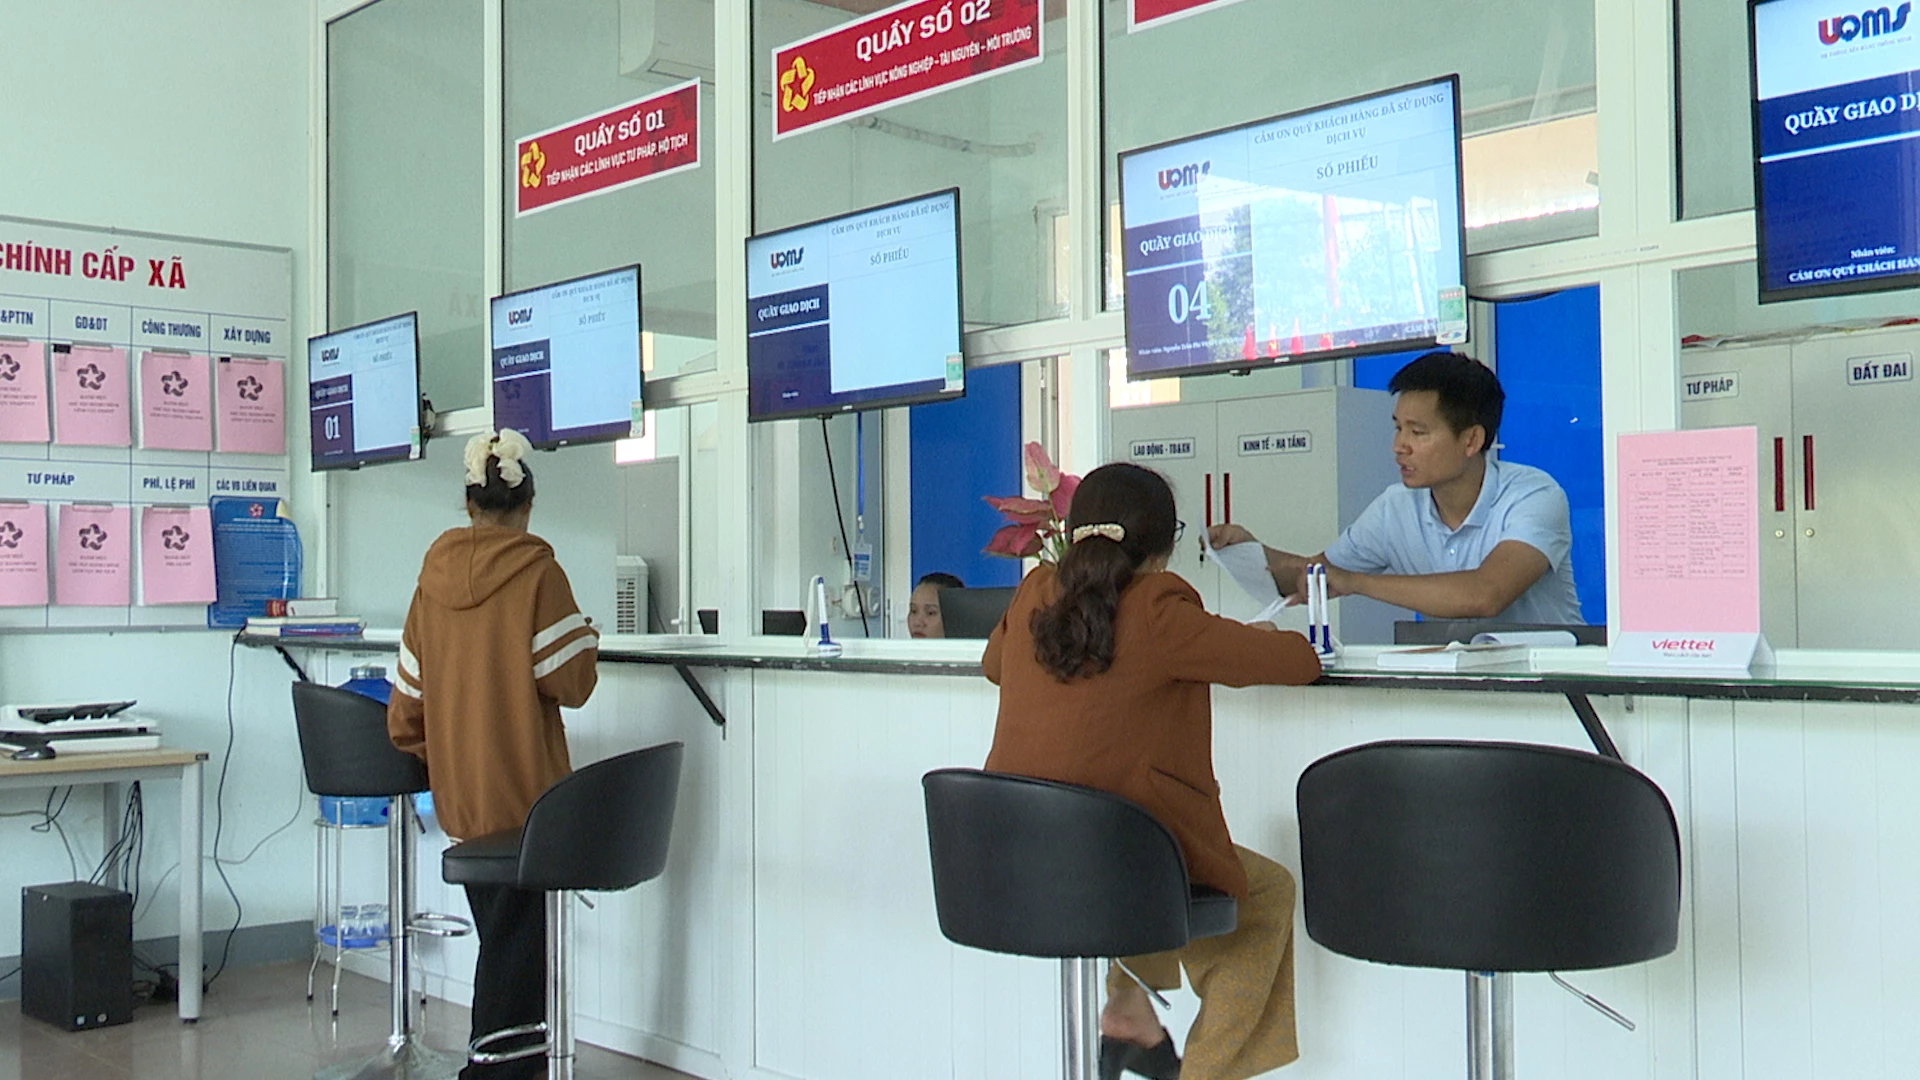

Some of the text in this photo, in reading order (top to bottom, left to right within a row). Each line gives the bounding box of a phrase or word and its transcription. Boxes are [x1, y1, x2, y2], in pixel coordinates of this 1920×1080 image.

[856, 0, 991, 62] QUẦY SỐ 02
[1314, 115, 1349, 132] KHÁCH
[1350, 108, 1379, 123] HÀNG
[1414, 93, 1445, 110] DỤNG
[1843, 96, 1896, 121] GIAO
[575, 109, 665, 156] QUẦY SỐ 01
[1326, 129, 1351, 145] DỊCH
[1317, 153, 1378, 180] SỐ PHIẾU
[1173, 230, 1203, 247] GIAO
[0, 240, 186, 289] HÍNH CẤP XÃ
[882, 247, 910, 263] PHIẾU
[1856, 260, 1896, 274] KHÁCH
[779, 302, 799, 315] GIAO
[800, 297, 820, 312] DỊCH
[1168, 281, 1212, 324] 04
[1853, 361, 1907, 380] ĐẤT ĐAI
[1686, 377, 1734, 396] TƯ PHÁP
[325, 415, 341, 440] 01
[27, 472, 75, 486] TƯ PHÁP
[165, 476, 177, 492] LỆ
[179, 477, 196, 490] PHÍ
[216, 478, 230, 490] CÁC
[242, 479, 257, 491] LIÊN
[259, 481, 277, 492] QUAN
[1652, 639, 1714, 651] viettel
